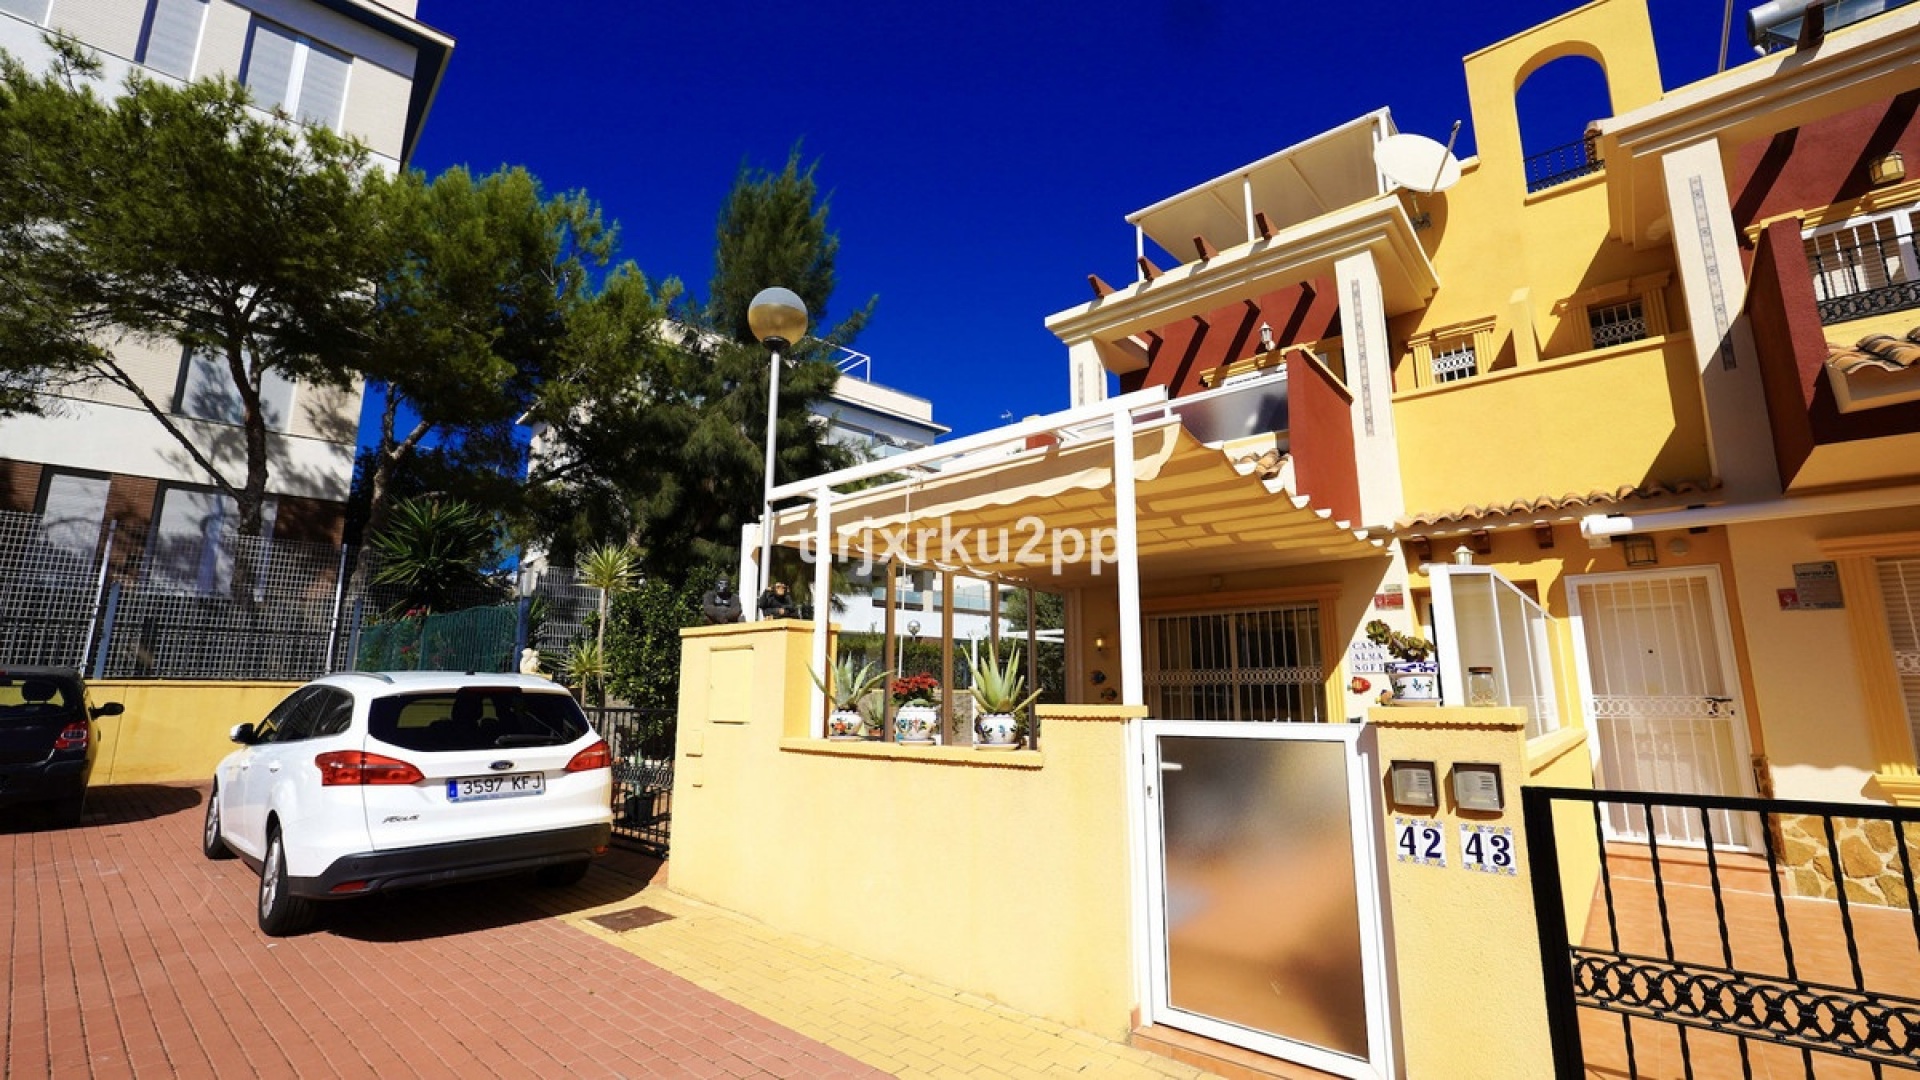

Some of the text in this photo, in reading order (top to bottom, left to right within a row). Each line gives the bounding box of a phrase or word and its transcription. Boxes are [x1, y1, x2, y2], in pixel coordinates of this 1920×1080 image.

[463, 777, 503, 796] 3597
[512, 774, 541, 791] KFJ
[1399, 826, 1442, 859] 42
[1465, 832, 1511, 867] 43
